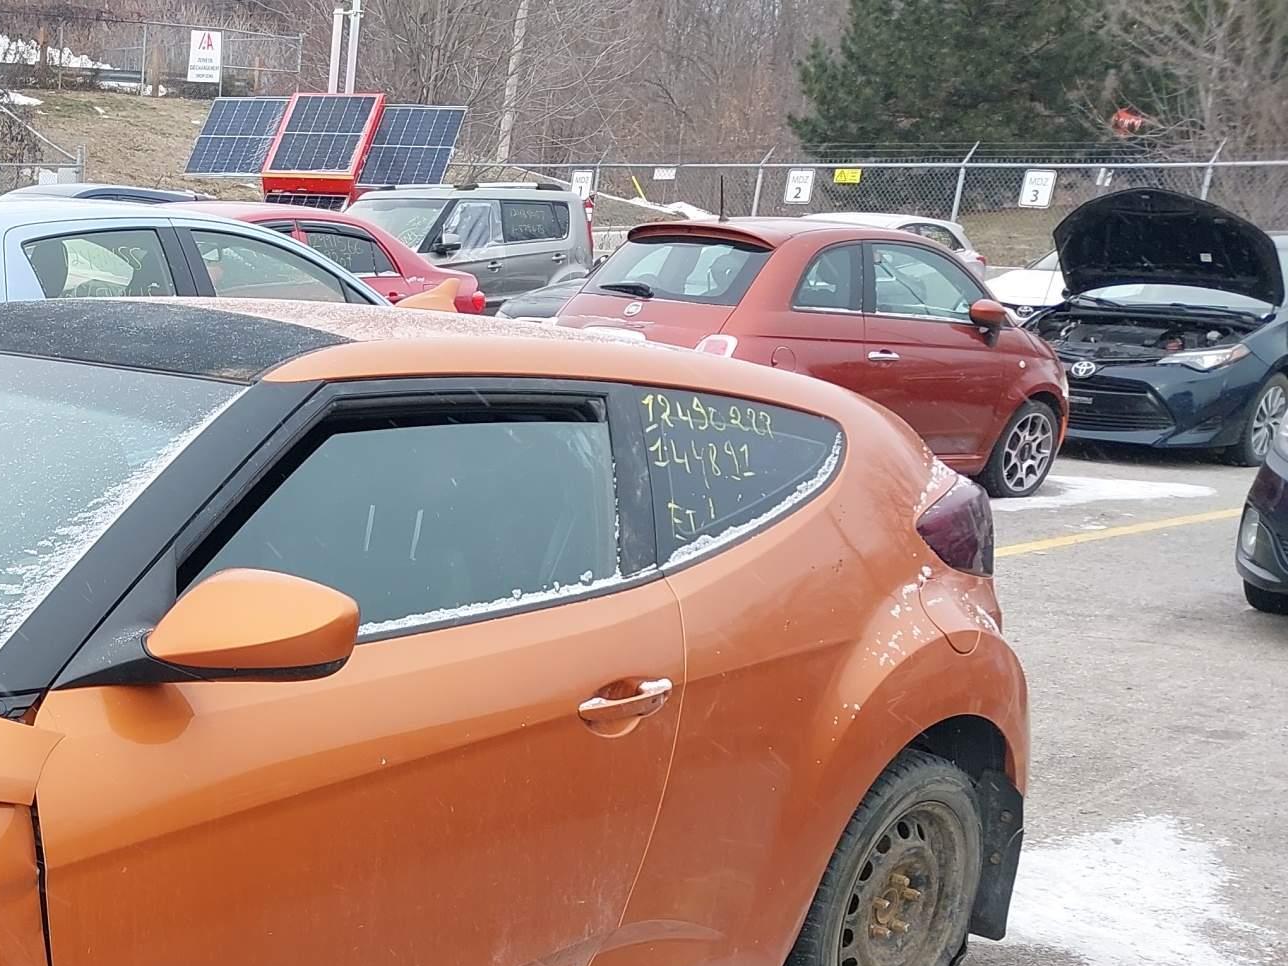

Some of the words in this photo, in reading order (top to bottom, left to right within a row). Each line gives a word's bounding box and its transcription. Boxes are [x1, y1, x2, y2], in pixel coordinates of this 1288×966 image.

[574, 176, 590, 184] MDZ
[792, 176, 810, 184] MDZ
[1028, 177, 1049, 186] MDZ
[793, 186, 802, 199] 2
[1030, 189, 1040, 202] 3
